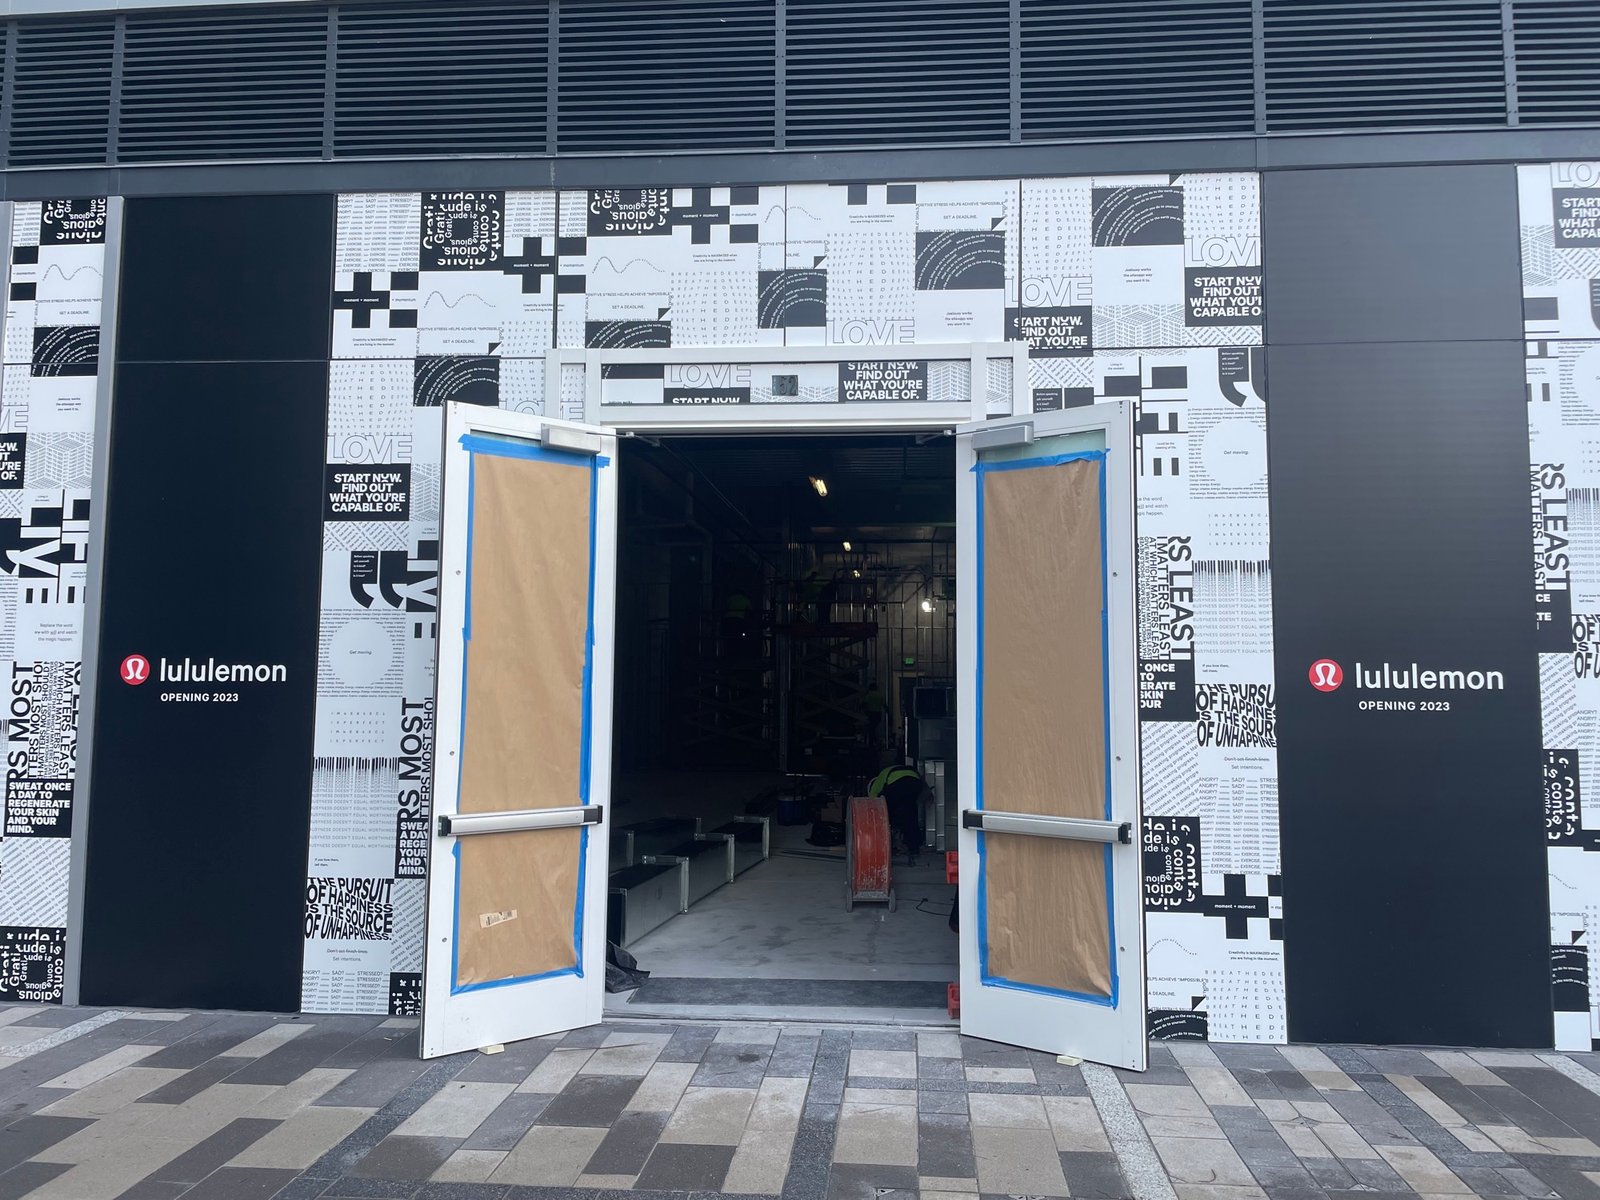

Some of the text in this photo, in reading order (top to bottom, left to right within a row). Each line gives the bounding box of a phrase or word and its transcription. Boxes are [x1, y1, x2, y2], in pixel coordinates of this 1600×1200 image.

[1572, 208, 1600, 218] FIND
[1559, 218, 1596, 228] WHAT
[1184, 236, 1260, 267] LOV
[1194, 276, 1234, 287] START
[1005, 276, 1092, 308] LOVE
[1203, 286, 1260, 296] FIND OUT
[1190, 298, 1227, 307] WHAT
[1193, 306, 1249, 317] CAPABLE
[1052, 316, 1083, 326] NOW.
[826, 320, 915, 345] LOVE
[1048, 326, 1074, 336] OUT
[1044, 336, 1088, 346] YOU'RE
[848, 362, 886, 370] START
[664, 364, 750, 388] LOVE
[856, 370, 910, 380] FIND OUT
[844, 380, 922, 390] WHAT YOU'RE
[846, 390, 920, 400] CAPABLE OF.
[327, 435, 412, 464] LOVE
[3, 471, 18, 480] OF.
[334, 474, 402, 483] START NOW.
[342, 484, 394, 492] FIND OUT
[329, 493, 406, 502] WHAT YOU'RE
[332, 502, 402, 512] CAPABLE OF.
[1542, 498, 1570, 590] LEAST
[1149, 551, 1158, 582] WHICH
[1150, 584, 1158, 628] MATTERS
[1157, 543, 1170, 660] MATTERS LEAST
[1169, 571, 1194, 660] LEAST
[1573, 622, 1595, 642] OF
[160, 658, 286, 682] lululemon
[1144, 664, 1176, 672] ONCE
[1574, 652, 1592, 678] OF
[1140, 672, 1154, 681] TO
[1356, 662, 1504, 690] lululemon
[1196, 684, 1228, 694] THE
[8, 661, 34, 742] MOST
[160, 693, 238, 702] OPENING 2023
[1196, 690, 1218, 711] OF
[1358, 701, 1450, 711] OPENING 2023
[30, 696, 42, 734] MOST
[1214, 710, 1240, 728] THE
[60, 667, 74, 778] MATTERS LEAST
[54, 708, 62, 749] MATTERS
[1197, 720, 1215, 747] OF
[398, 697, 424, 780] MOST
[421, 733, 432, 772] MOST
[9, 782, 72, 791] SWEAT ONCE
[8, 800, 70, 808] REGENERATE
[7, 816, 56, 825] AND YOUR
[6, 825, 34, 833] MIND.
[400, 831, 428, 839] A DAY
[400, 848, 427, 857] YOUR
[308, 876, 394, 904] THE PURSUIT
[306, 884, 394, 913] OF HAPPINESS
[306, 904, 393, 933] IS THE SOURCE
[305, 913, 392, 940] OF UNHAPPINESS.
